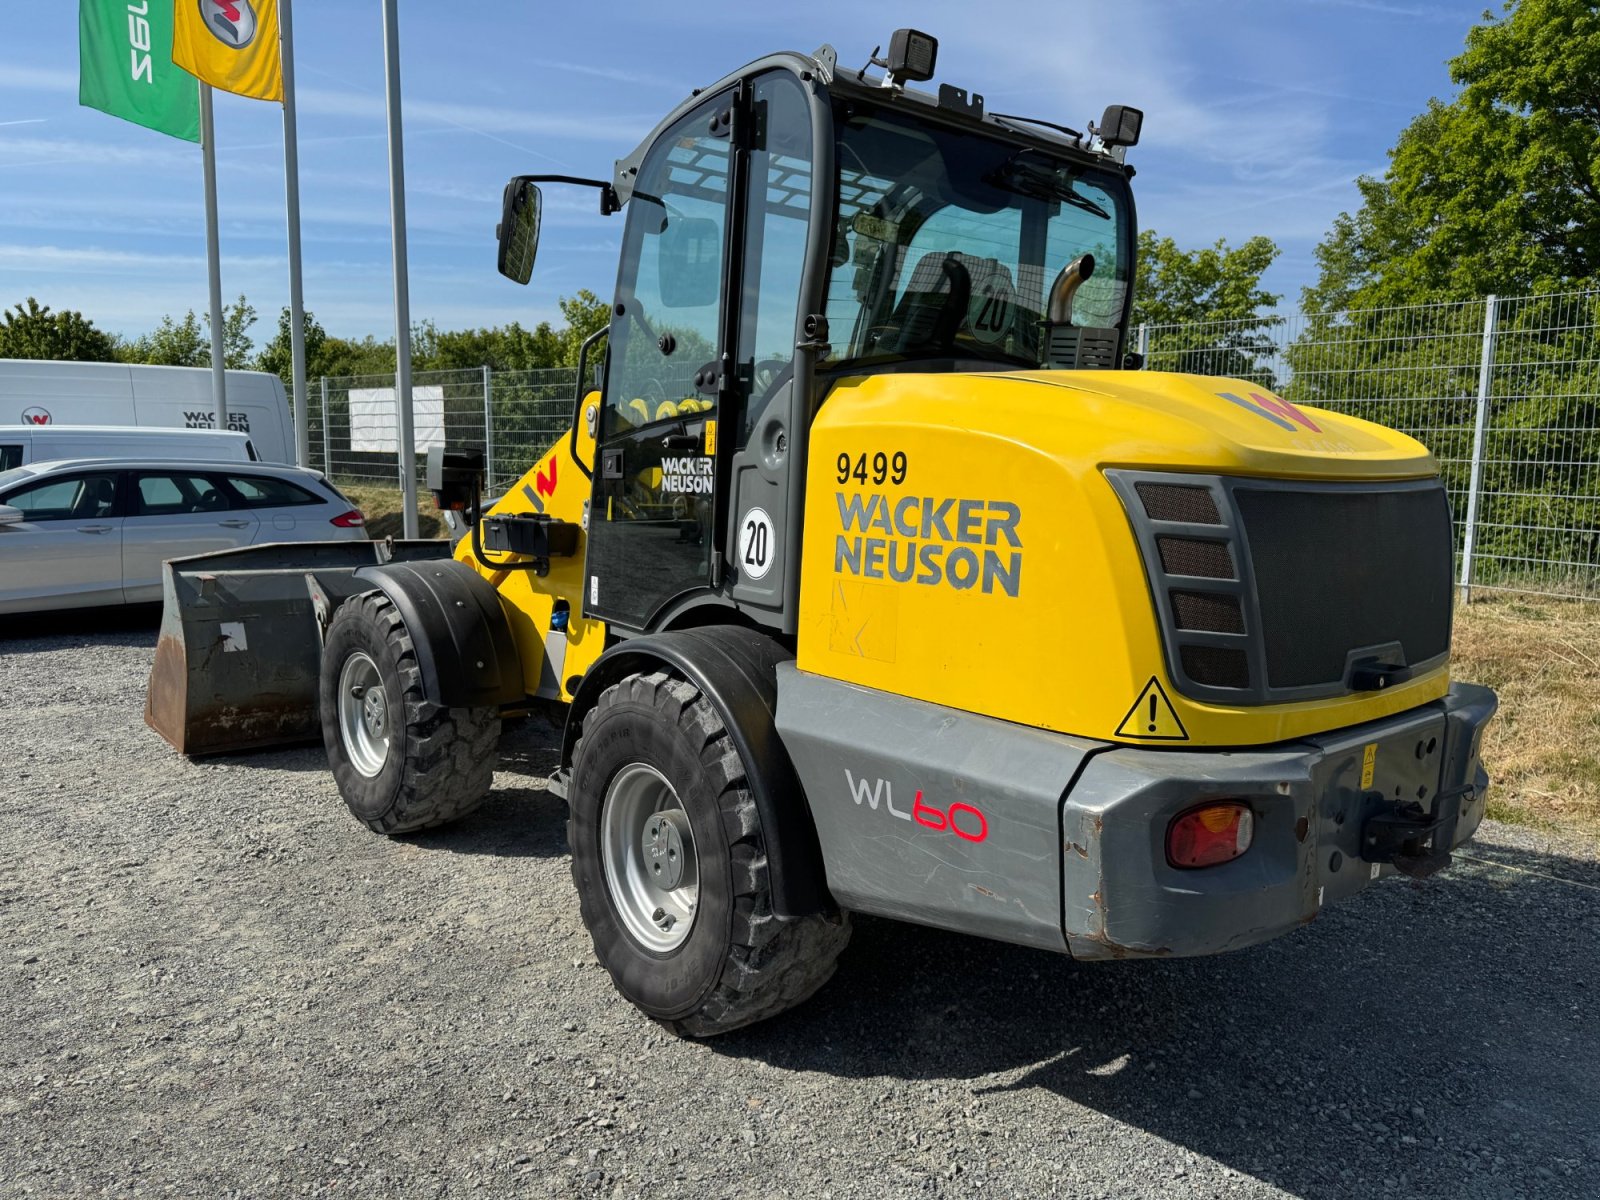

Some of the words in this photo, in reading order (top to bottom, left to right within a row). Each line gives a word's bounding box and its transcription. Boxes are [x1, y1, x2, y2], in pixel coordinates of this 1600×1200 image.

[976, 284, 1007, 333] 20
[183, 411, 249, 423] WACER
[185, 422, 251, 433] NEON
[661, 457, 713, 476] WACKER
[661, 475, 714, 494] NEUSON
[836, 451, 908, 486] 9499
[835, 492, 1024, 549] WACKER
[745, 520, 768, 568] 20
[833, 534, 1023, 598] NEUSON
[844, 768, 989, 844] WL60
